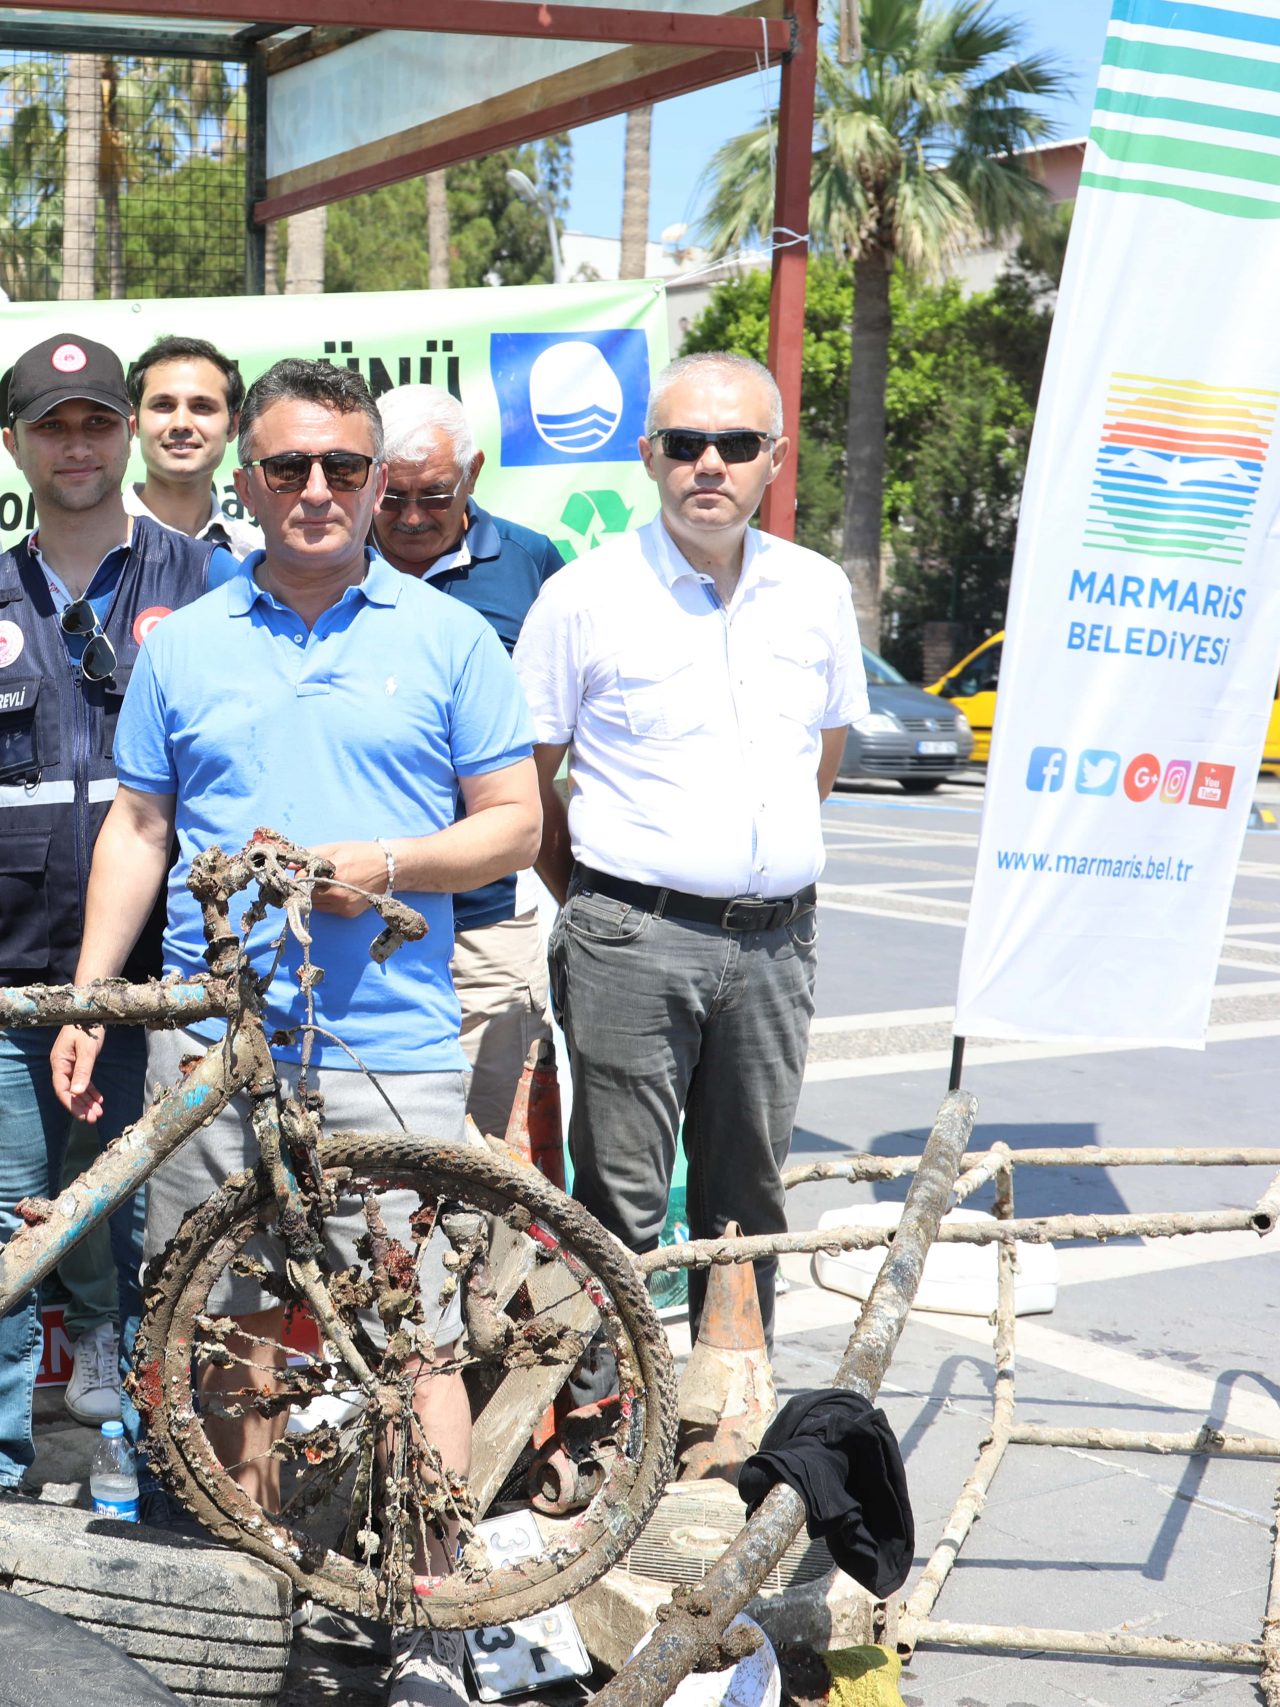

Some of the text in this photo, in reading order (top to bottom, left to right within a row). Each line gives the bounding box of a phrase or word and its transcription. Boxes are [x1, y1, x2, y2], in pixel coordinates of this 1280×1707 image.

[1068, 569, 1247, 620] MARMARİS
[1067, 621, 1231, 666] BELEDİYESİ
[997, 850, 1194, 882] www.marmaris.bel.tr
